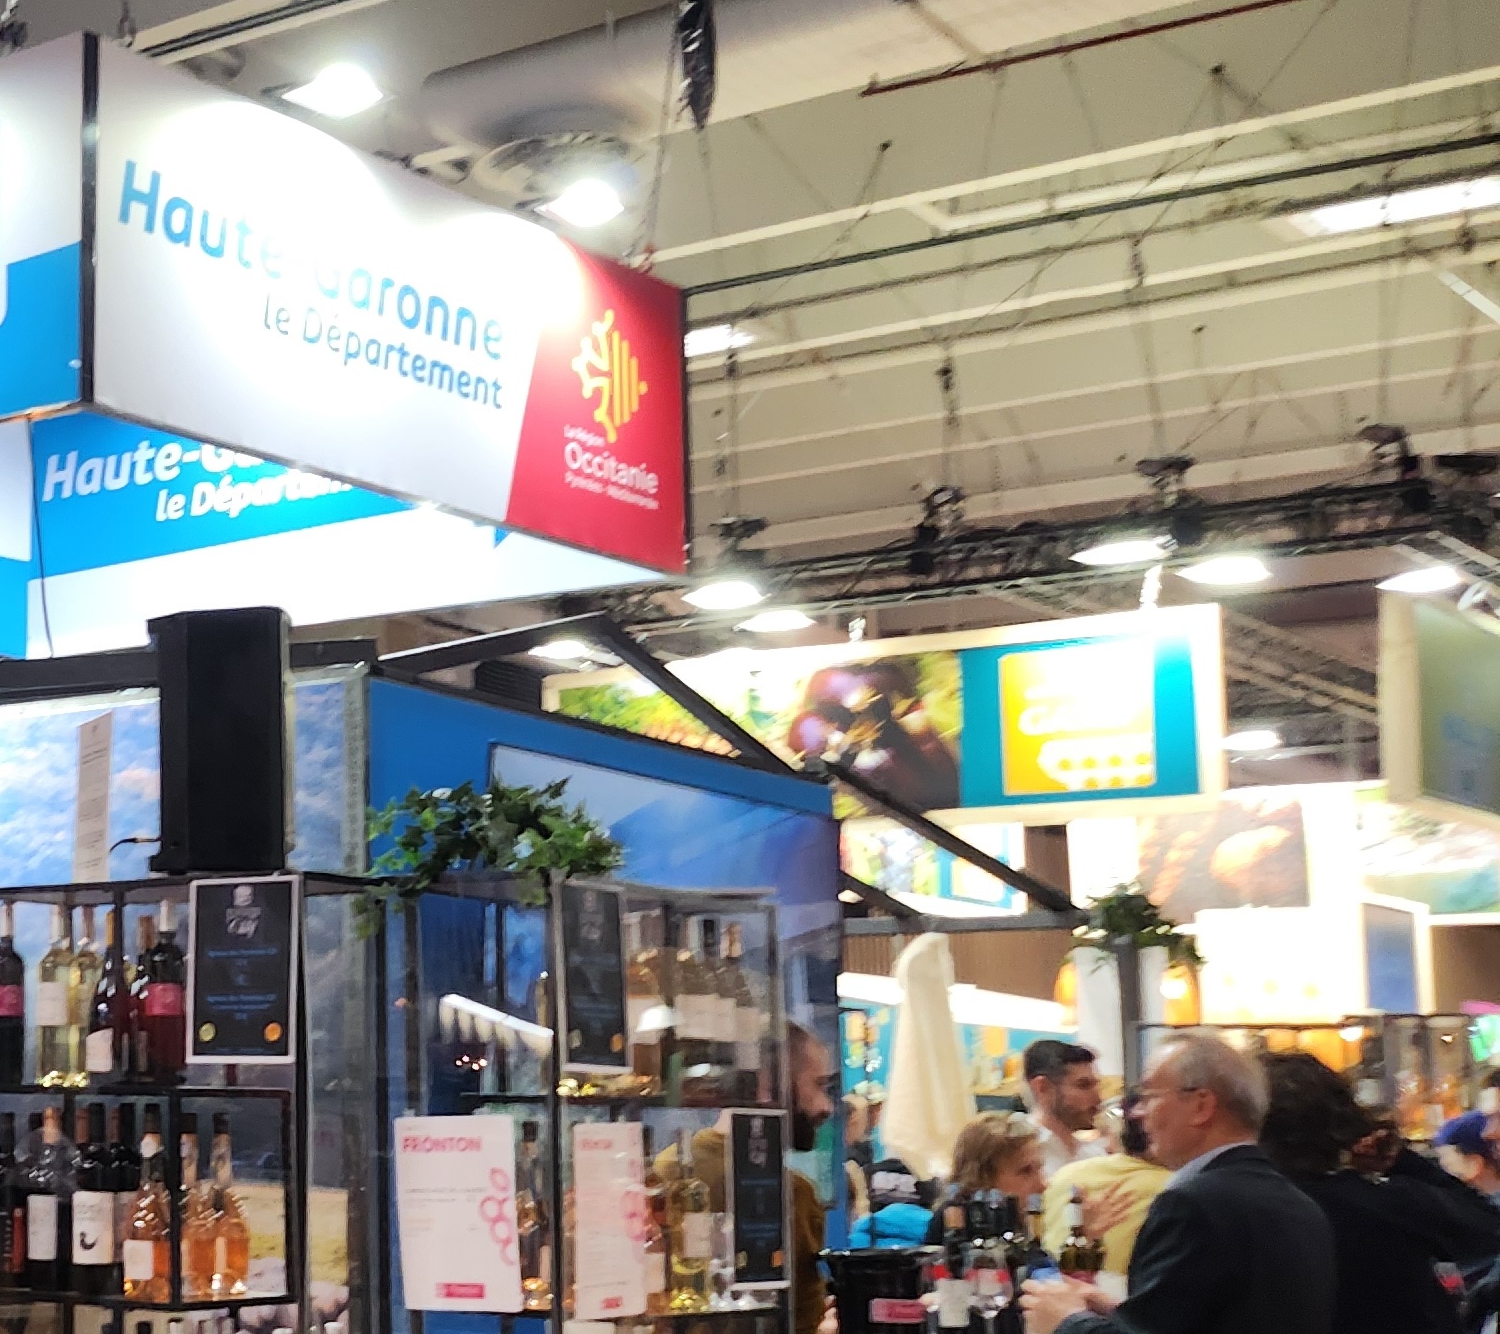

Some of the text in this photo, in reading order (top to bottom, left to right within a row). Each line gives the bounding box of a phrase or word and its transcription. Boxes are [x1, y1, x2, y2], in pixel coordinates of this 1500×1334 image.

[118, 159, 503, 360] HauteGaronne
[263, 291, 503, 410] le Département
[155, 488, 187, 523] le
[563, 441, 659, 495] Occitanie
